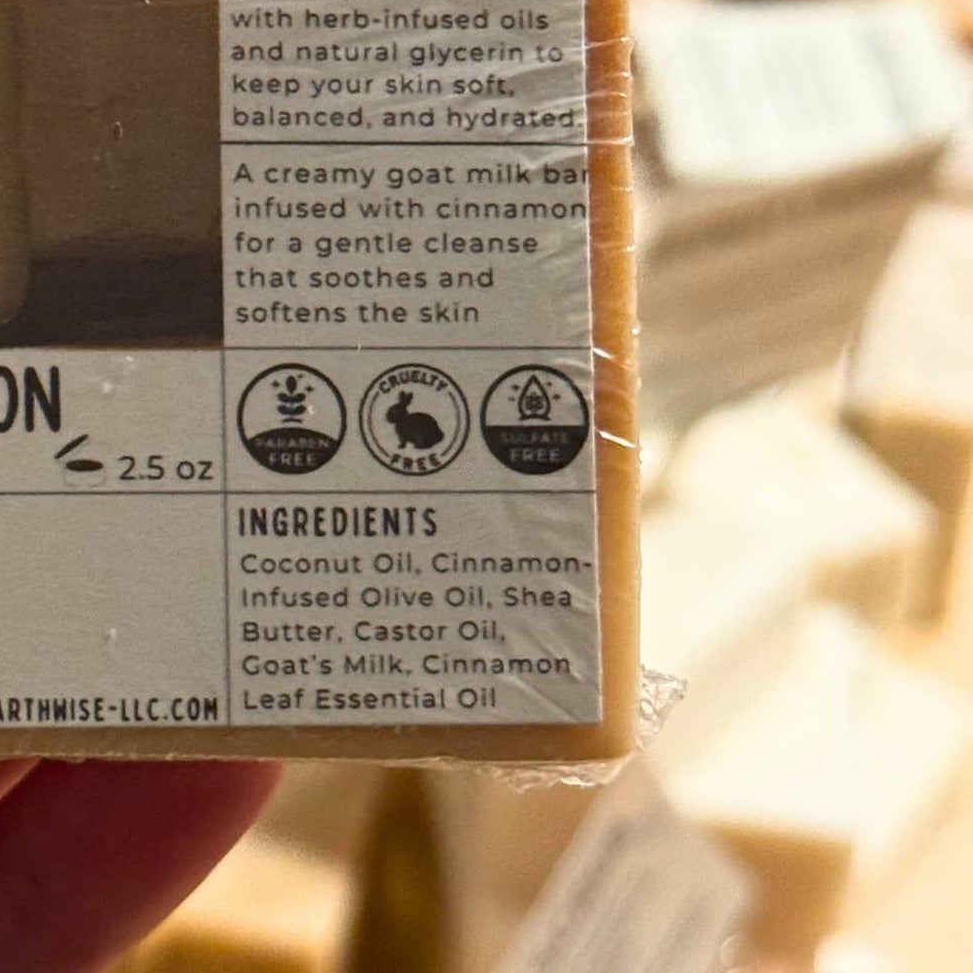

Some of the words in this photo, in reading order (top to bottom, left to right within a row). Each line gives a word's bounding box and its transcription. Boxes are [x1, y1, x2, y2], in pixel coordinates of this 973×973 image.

[231, 11, 292, 29] with
[305, 10, 489, 29] herb-infused
[501, 11, 549, 29] oils
[231, 43, 283, 61] and
[296, 43, 398, 61] natural
[410, 43, 523, 66] glycerin
[536, 46, 563, 62] to
[233, 75, 300, 97] keep
[311, 76, 373, 98] your
[385, 76, 442, 94] skin
[453, 76, 515, 96] soft,
[234, 108, 371, 128] balanced,
[383, 108, 434, 126] and
[447, 107, 583, 130] hydrated.
[234, 164, 253, 182] A
[265, 166, 374, 188] creamy
[387, 166, 455, 188] goat
[467, 164, 530, 183] milk
[234, 198, 347, 218] infused
[359, 200, 424, 219] with
[436, 200, 586, 219] cinnamon
[234, 233, 274, 252] for
[288, 236, 302, 252] a
[316, 233, 412, 257] gentle
[424, 233, 538, 253] cleanse
[235, 269, 297, 288] that
[309, 268, 427, 288] soothes
[440, 269, 494, 288] and
[236, 303, 346, 323] softens
[359, 304, 408, 323] the
[420, 303, 479, 323] skin
[379, 370, 448, 394] CRUELTY
[269, 454, 315, 465] FREE
[389, 454, 441, 470] FREE
[509, 449, 560, 462] FREE
[118, 455, 164, 480] 2.5
[177, 460, 213, 480] oz
[238, 507, 438, 537] INGREDIENTS
[241, 553, 361, 574] Coconut
[374, 553, 421, 574] Oil,
[432, 553, 591, 573] Cinnamon-
[242, 587, 348, 608] Infused
[361, 587, 433, 607] Olive
[446, 587, 492, 608] Oil,
[504, 587, 572, 607] Shea
[242, 621, 342, 643] Butter,
[355, 621, 447, 641] Castor
[459, 621, 505, 641] Oil,
[242, 655, 332, 676] Goat's
[344, 654, 411, 676] Milk,
[423, 654, 570, 674] Cinnamon
[244, 689, 305, 710] Leaf
[315, 688, 445, 709] Essential
[458, 687, 496, 708] Oil
